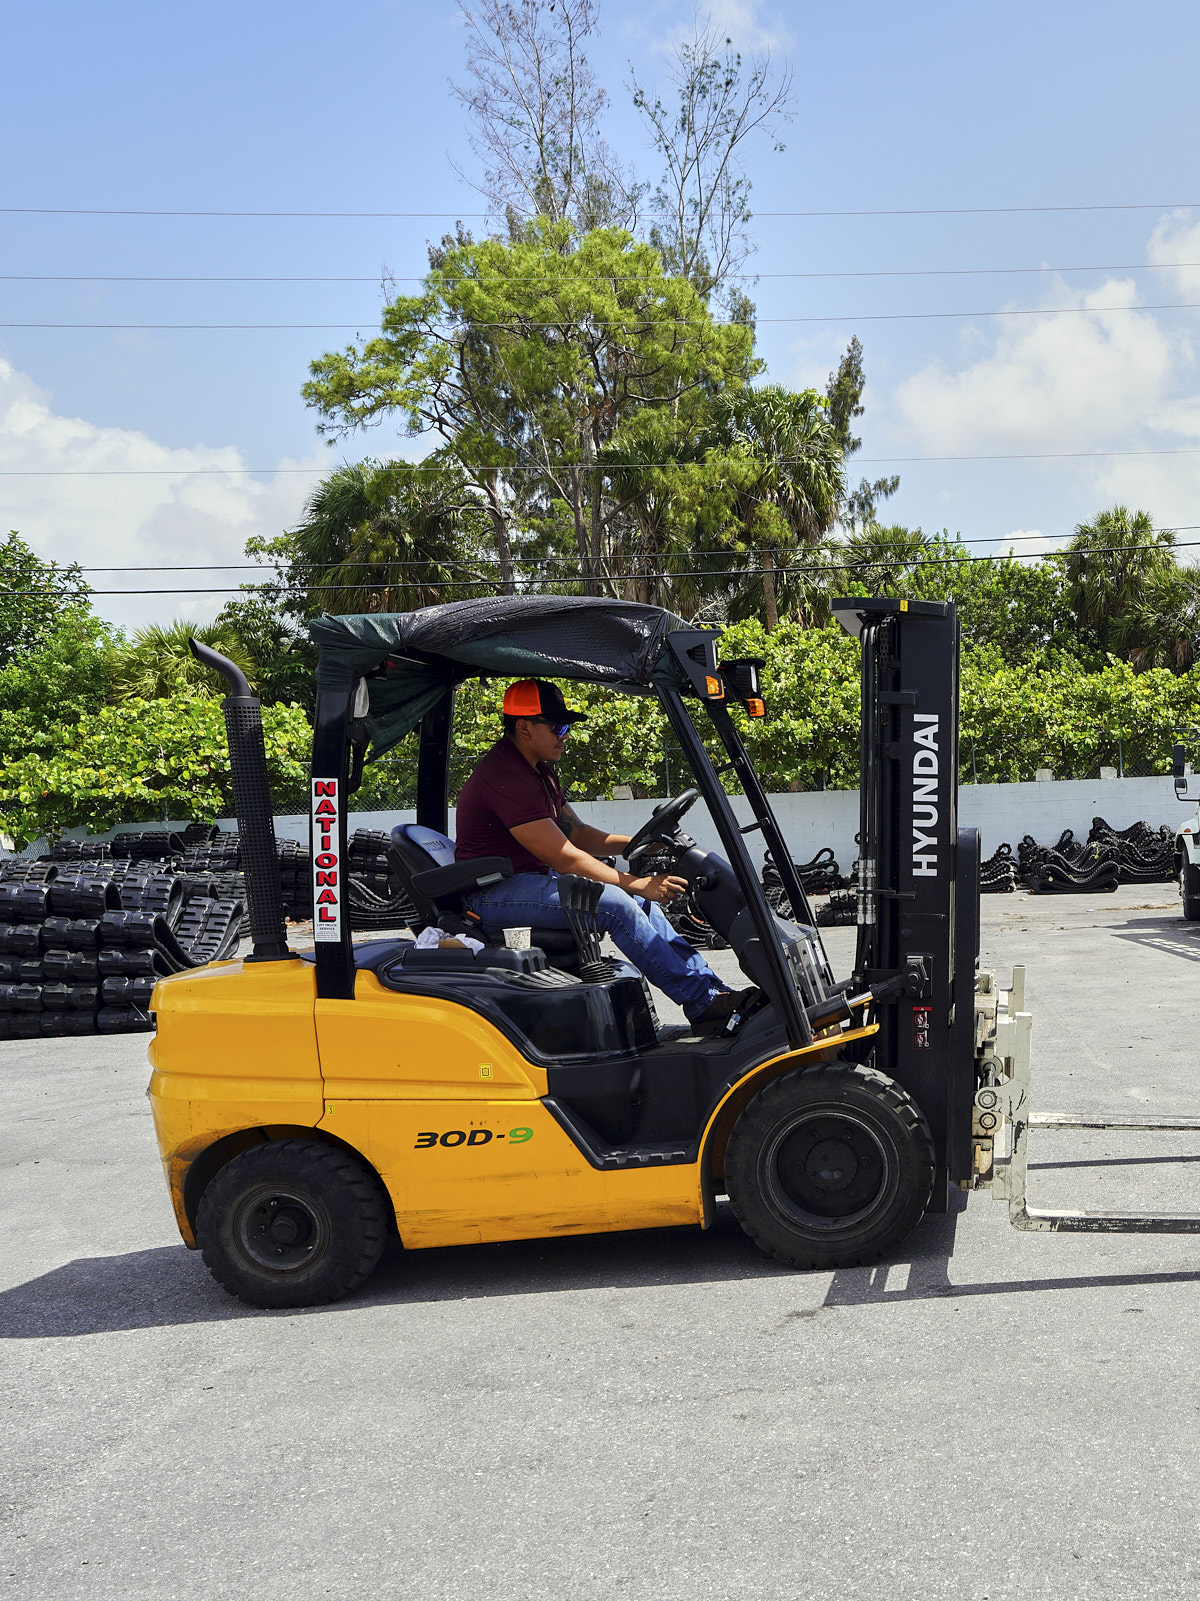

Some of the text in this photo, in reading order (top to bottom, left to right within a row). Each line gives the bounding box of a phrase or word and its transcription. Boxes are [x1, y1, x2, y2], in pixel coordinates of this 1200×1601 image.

[314, 781, 338, 922] NATIONAL
[912, 714, 939, 876] HYUNDAI
[414, 1127, 534, 1149] 30D-9
